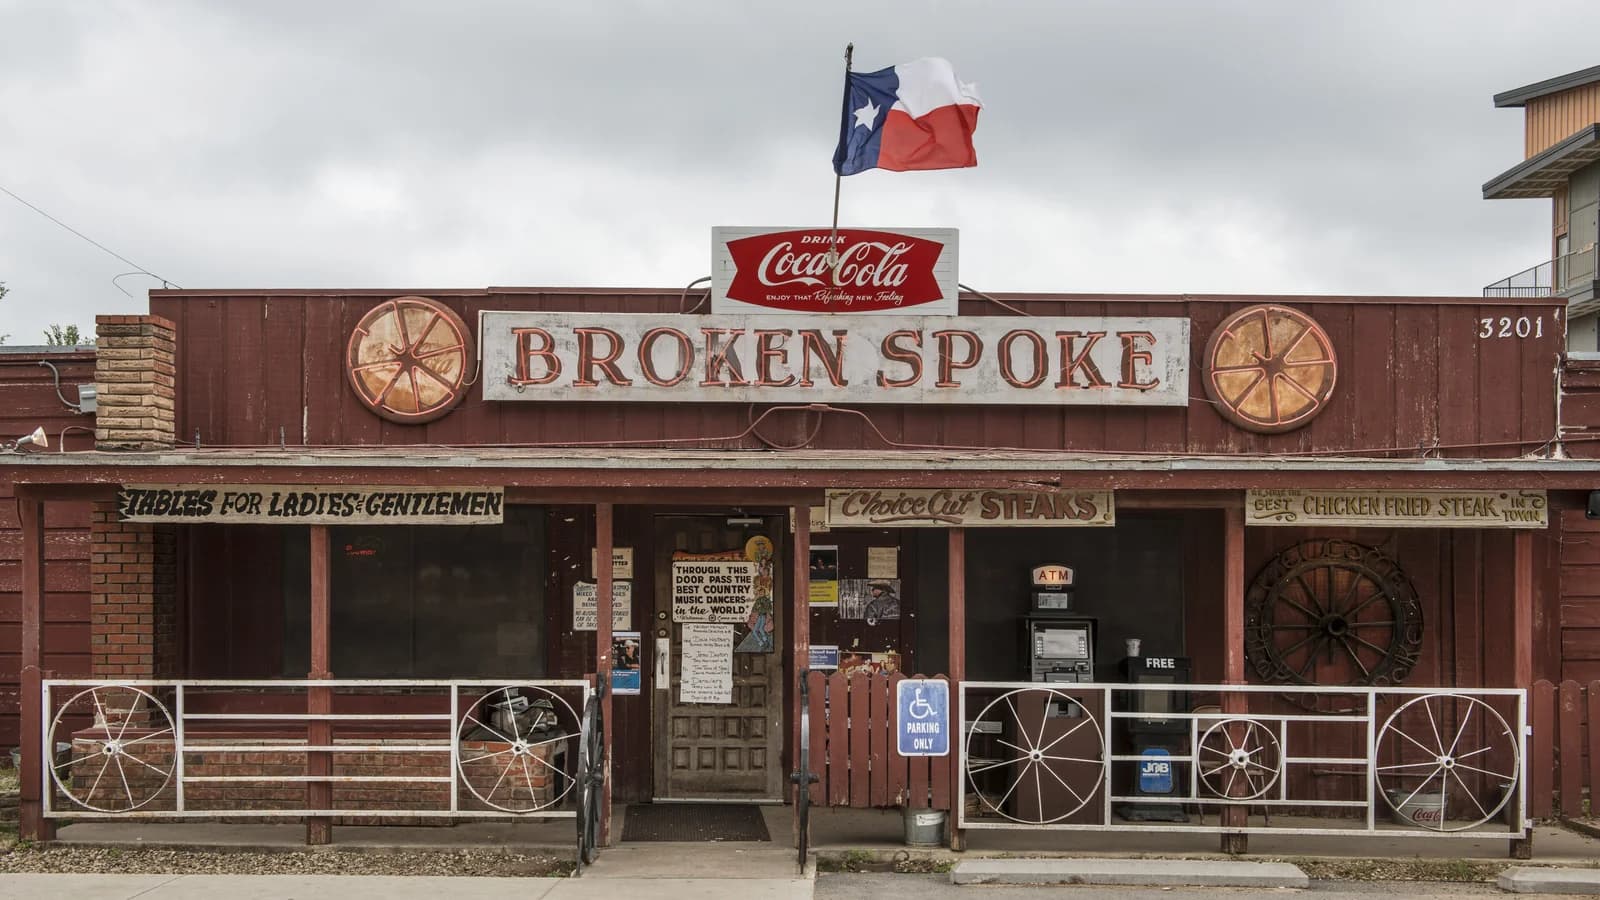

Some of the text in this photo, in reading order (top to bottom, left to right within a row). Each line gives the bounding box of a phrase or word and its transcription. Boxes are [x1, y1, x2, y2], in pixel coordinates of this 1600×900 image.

[801, 235, 846, 244] DRINK
[757, 241, 915, 287] CocaCola
[874, 290, 904, 305] Feeling
[1479, 316, 1543, 339] 3201
[508, 327, 850, 388] BROKEN
[876, 329, 1160, 391] SPOKE
[125, 489, 217, 517] TABLES
[219, 491, 263, 516] FOR
[267, 491, 360, 517] LADIES
[365, 491, 502, 517] GENTLEMEN
[841, 488, 1097, 520] Choice Cut STEAKS
[1254, 495, 1499, 517] BEST CHICKEN FRIED STEAK
[1510, 496, 1526, 508] IN
[1502, 509, 1540, 522] TOWN
[676, 566, 748, 574] THROUGH THIS
[1038, 570, 1069, 581] ATM
[676, 576, 752, 584] DOOR PASS THE
[676, 585, 751, 594] BEST COUNTRY
[675, 596, 746, 604] MUSIC DANCERS
[675, 605, 686, 615] in
[688, 605, 709, 615] the
[1146, 658, 1175, 669] FREE
[907, 722, 940, 734] PARKING
[913, 738, 934, 750] ONLY
